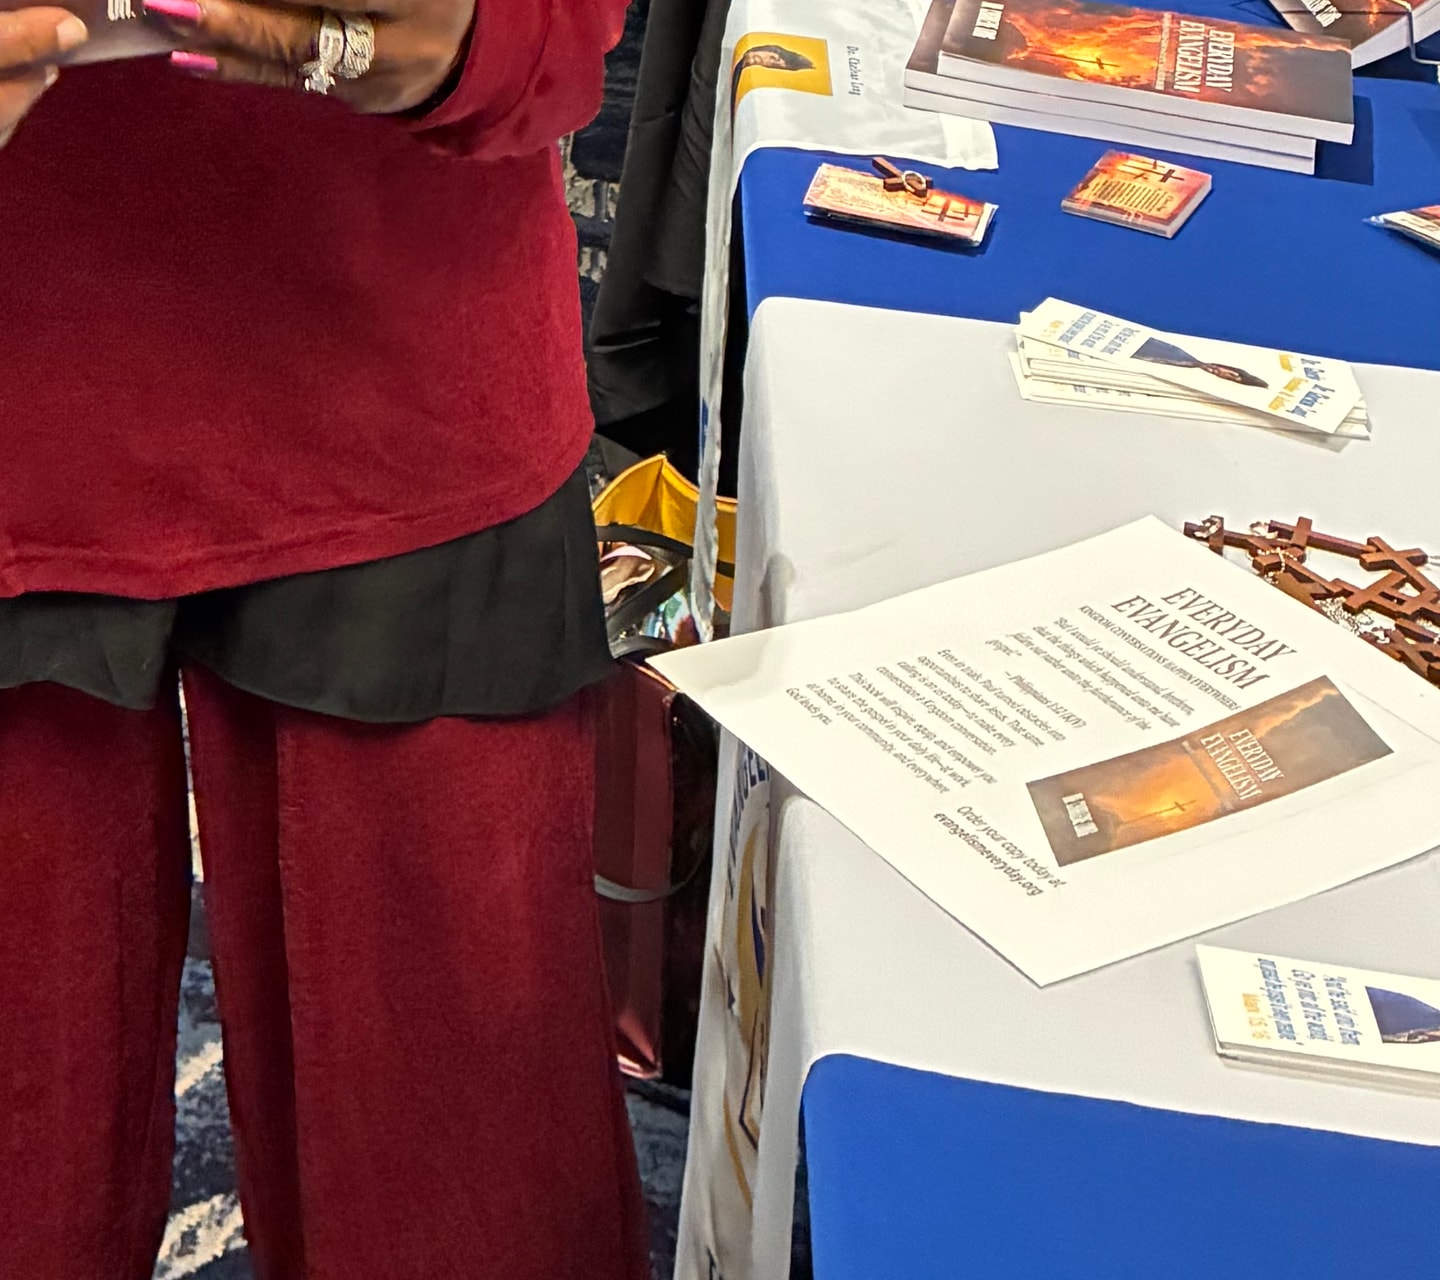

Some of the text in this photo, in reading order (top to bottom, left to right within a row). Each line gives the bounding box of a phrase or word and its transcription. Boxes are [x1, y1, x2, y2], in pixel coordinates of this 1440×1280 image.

[1173, 19, 1206, 93] EVANGELISM
[1205, 26, 1236, 92] EVERYDAY
[1112, 596, 1268, 689] EVANGELISM
[1162, 588, 1295, 661] EVERYDAY
[1201, 733, 1262, 800] EVANGELISM
[1229, 729, 1283, 781] EVERYDAY
[934, 813, 1043, 896] evangelismeveryday.org
[956, 806, 1067, 888] Order your copy today at
